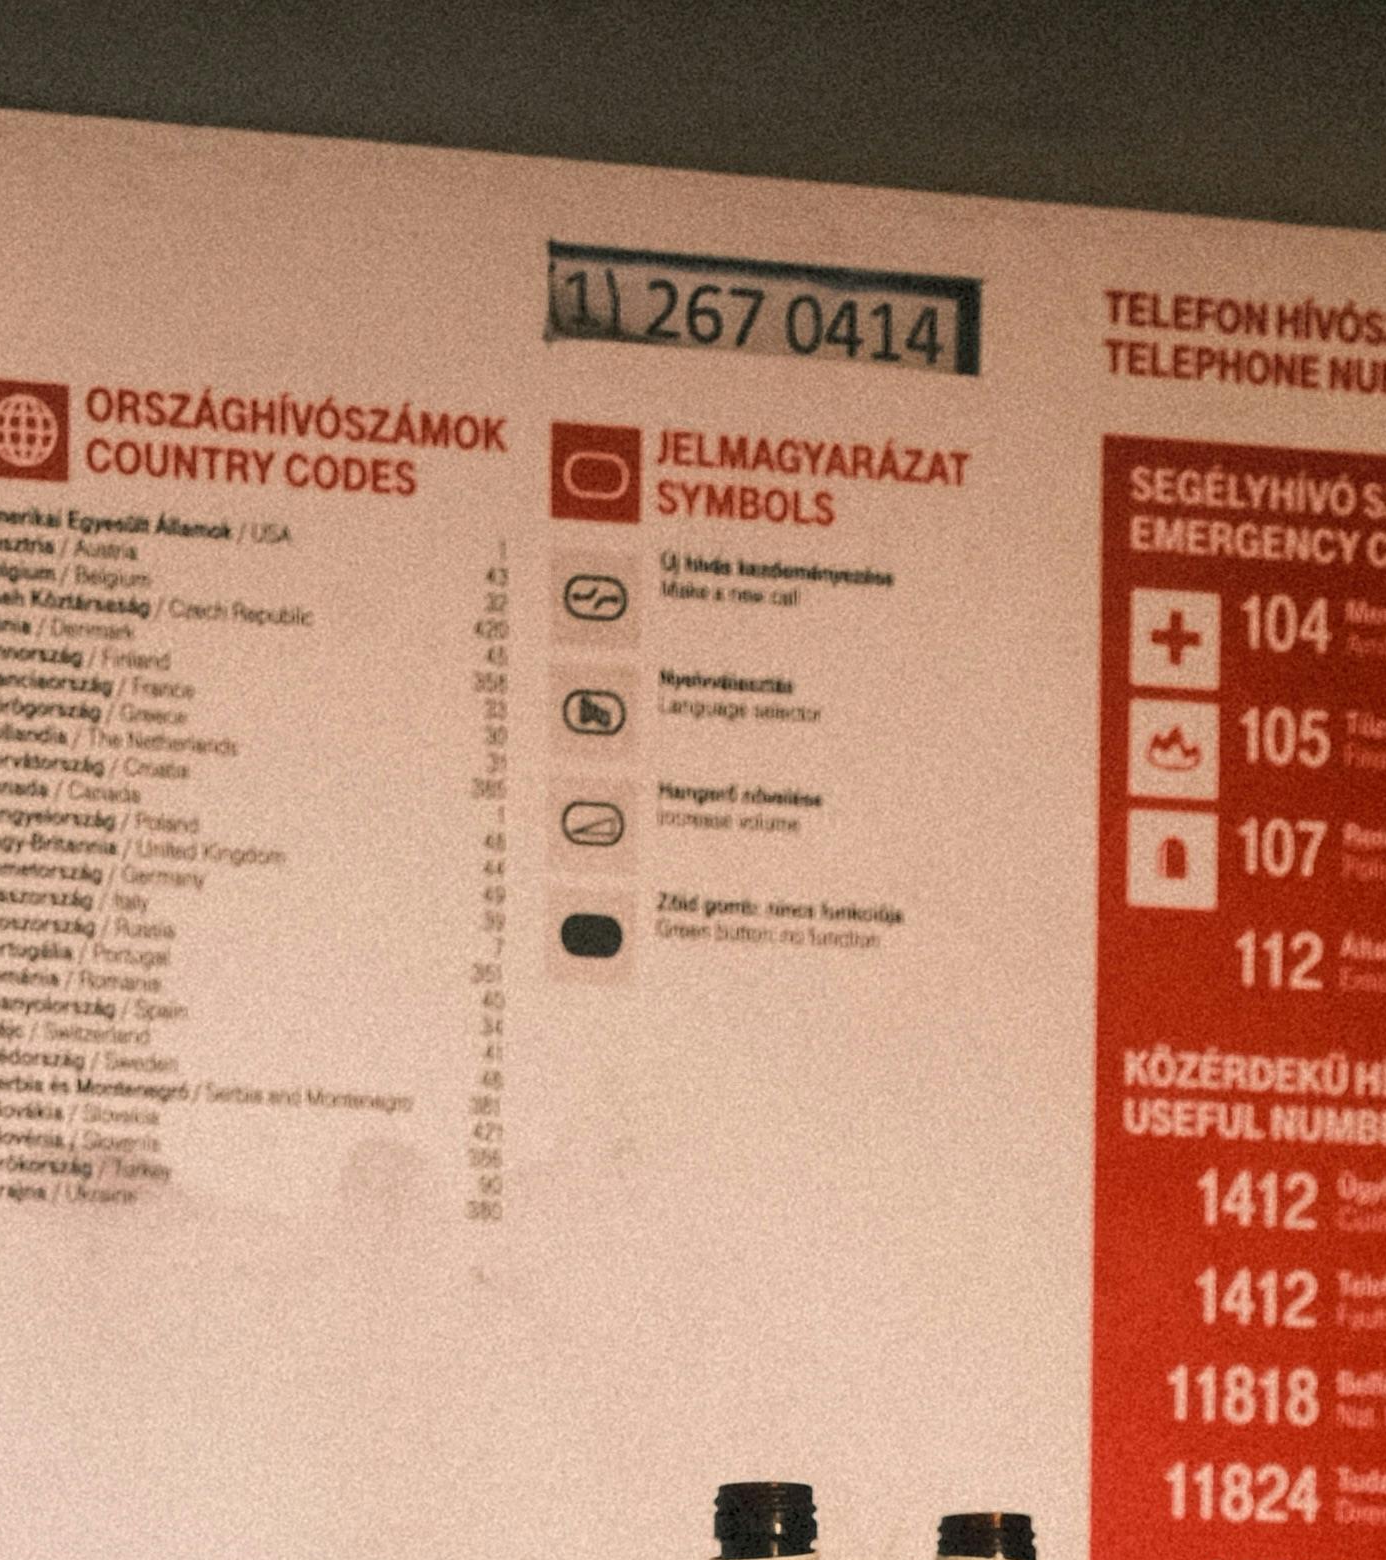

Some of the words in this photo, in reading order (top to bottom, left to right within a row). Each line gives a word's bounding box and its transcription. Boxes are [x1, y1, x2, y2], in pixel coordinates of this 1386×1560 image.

[645, 279, 766, 347] 267
[784, 294, 944, 364] 0414
[1104, 292, 1268, 337] TELEFON
[1104, 342, 1318, 390] TELEPHONE
[87, 387, 507, 451] ORSZÁGHÍVÓSZÁMOK
[87, 441, 275, 484] COUNTRY
[284, 454, 417, 496] CODES
[658, 432, 970, 487] JELMAGYARÁZAT
[658, 481, 835, 526] SYMBOLS
[1130, 465, 1356, 516] SEGÉLYHÍVÓ
[1130, 517, 1358, 564] EMERGENCY
[1241, 595, 1333, 655] 104
[1239, 707, 1332, 768] 105
[1238, 818, 1328, 878] 107
[1236, 931, 1324, 991] 112
[1123, 1047, 1349, 1096] KÖZÉRDEKŰ
[1123, 1100, 1264, 1139] USEFUL
[1197, 1168, 1319, 1230] 1412
[1196, 1268, 1319, 1329] 1412
[1167, 1365, 1320, 1426] 11818
[1166, 1462, 1321, 1524] 11824
